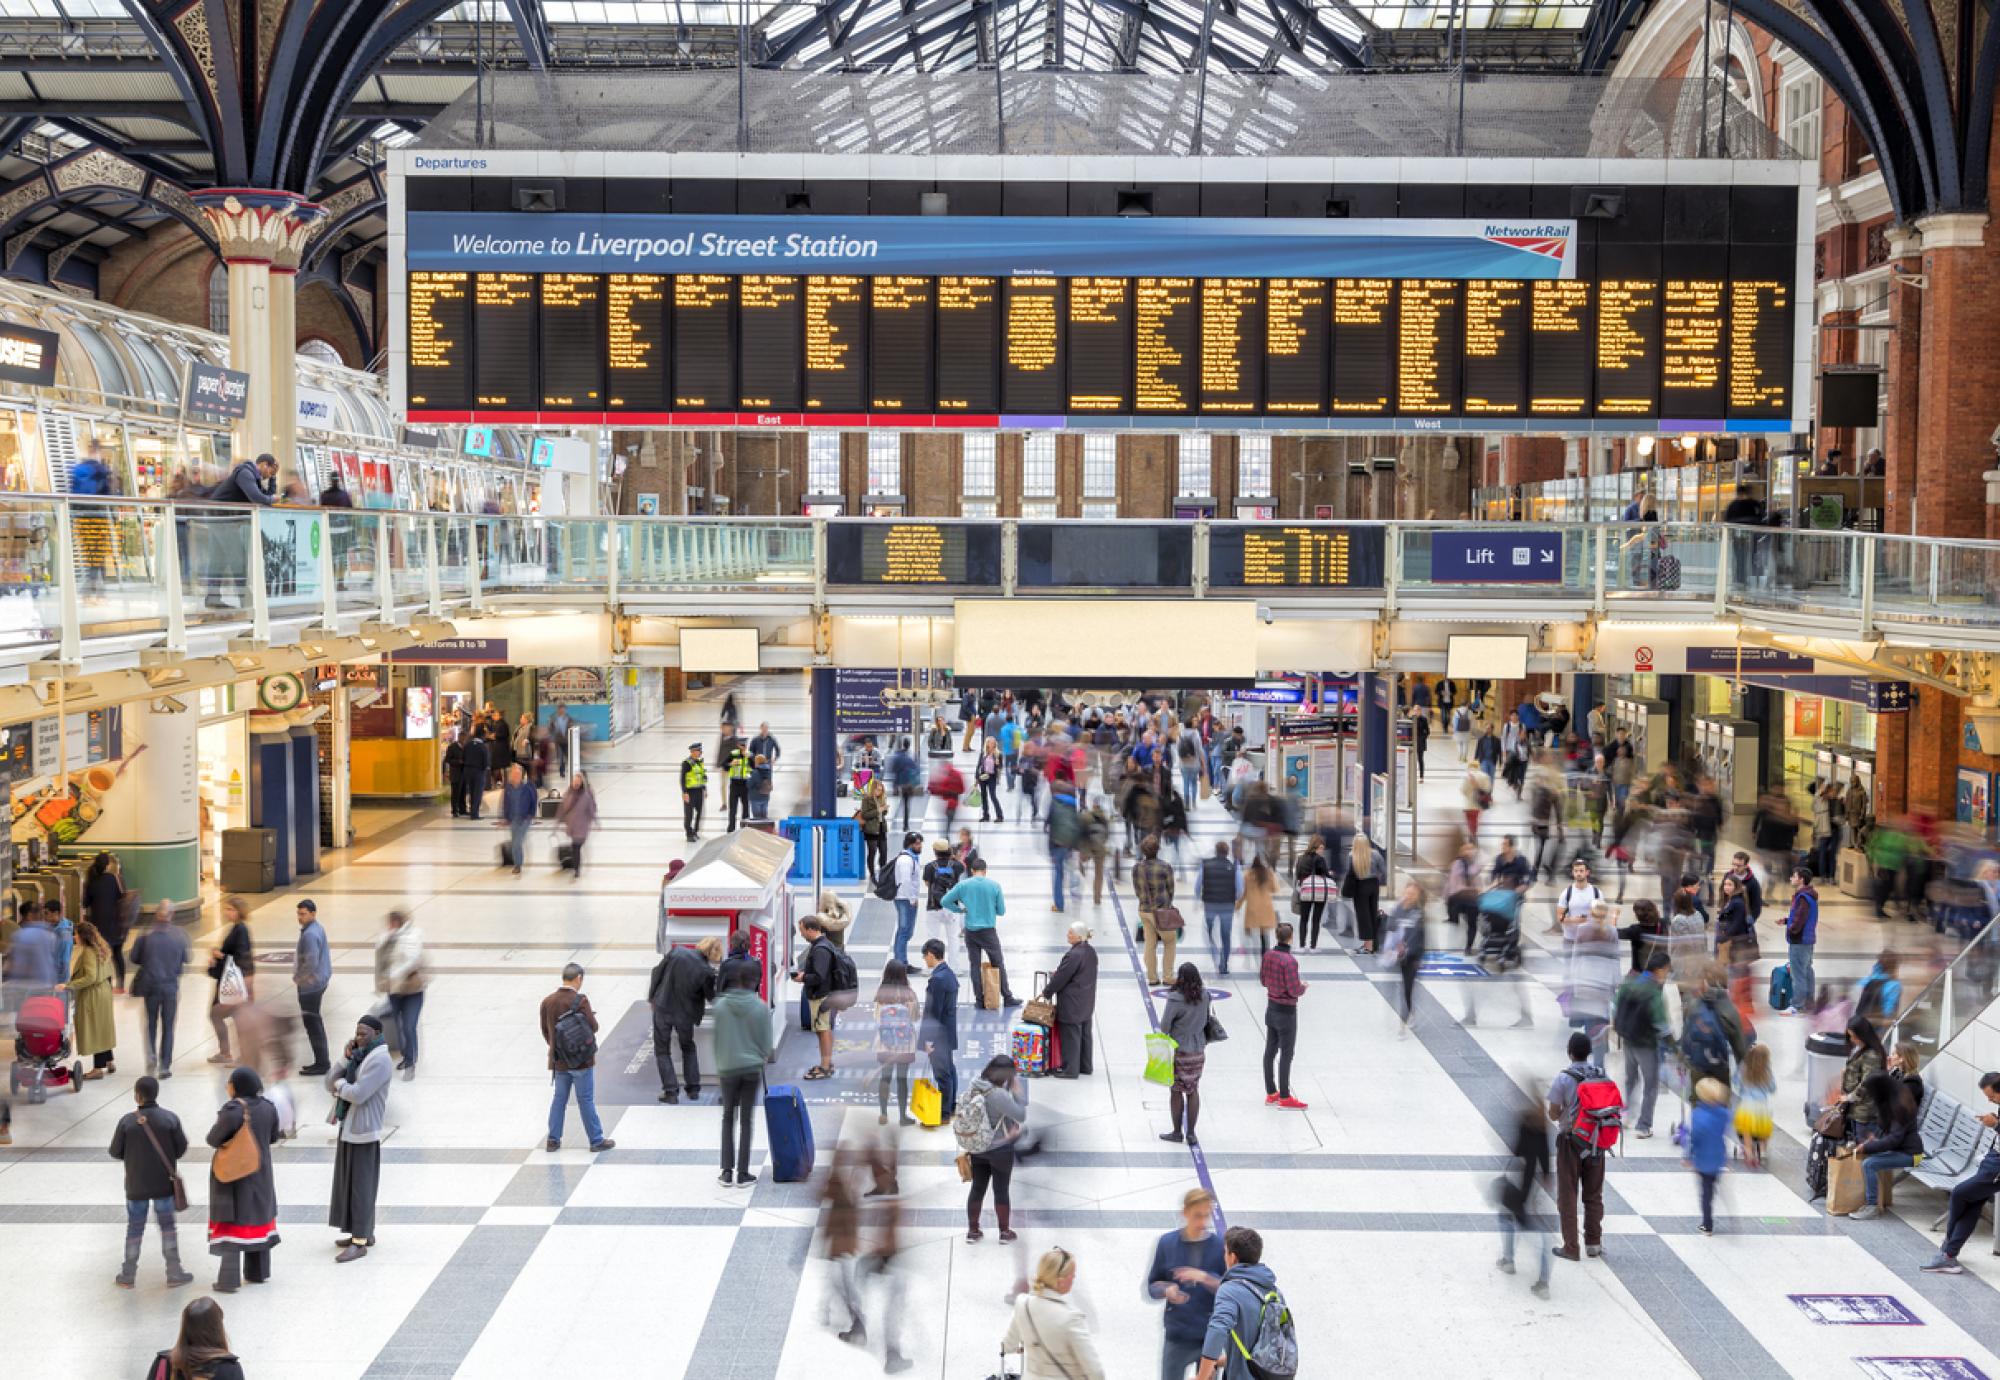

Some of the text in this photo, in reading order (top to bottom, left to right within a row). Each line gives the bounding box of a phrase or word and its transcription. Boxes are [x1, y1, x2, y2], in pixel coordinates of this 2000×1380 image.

[415, 156, 487, 170] Departures
[453, 232, 879, 263] Welcome to Liverpool Street Station
[757, 415, 781, 425] East
[1414, 419, 1441, 429] West
[1466, 548, 1495, 565] Lift
[346, 671, 376, 681] CASA
[669, 893, 760, 905] stanstedexpress.com
